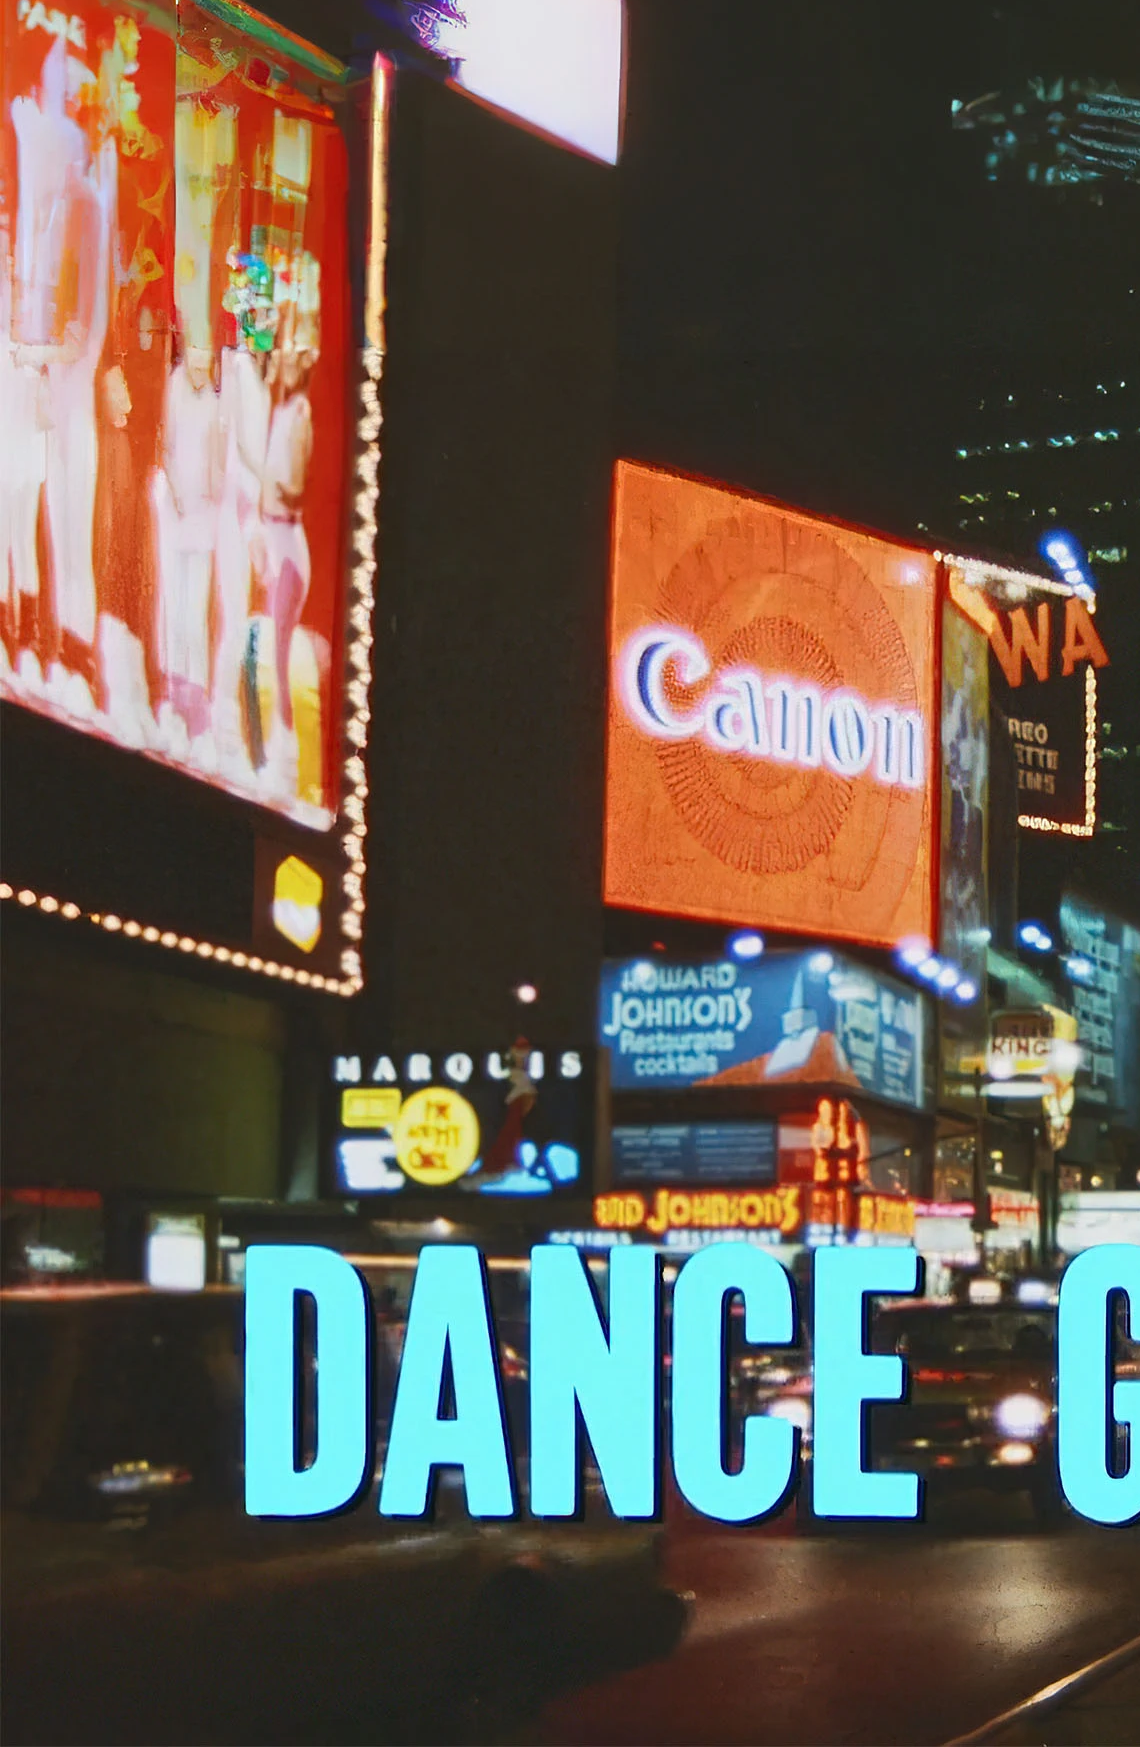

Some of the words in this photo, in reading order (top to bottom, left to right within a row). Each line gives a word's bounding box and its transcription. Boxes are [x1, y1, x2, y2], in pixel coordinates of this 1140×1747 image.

[616, 624, 925, 785] Canon
[621, 961, 738, 993] HOWARD
[602, 986, 753, 1037] JOHNSON'S
[991, 1036, 1050, 1055] KING
[646, 1186, 799, 1232] JOHNSON'S
